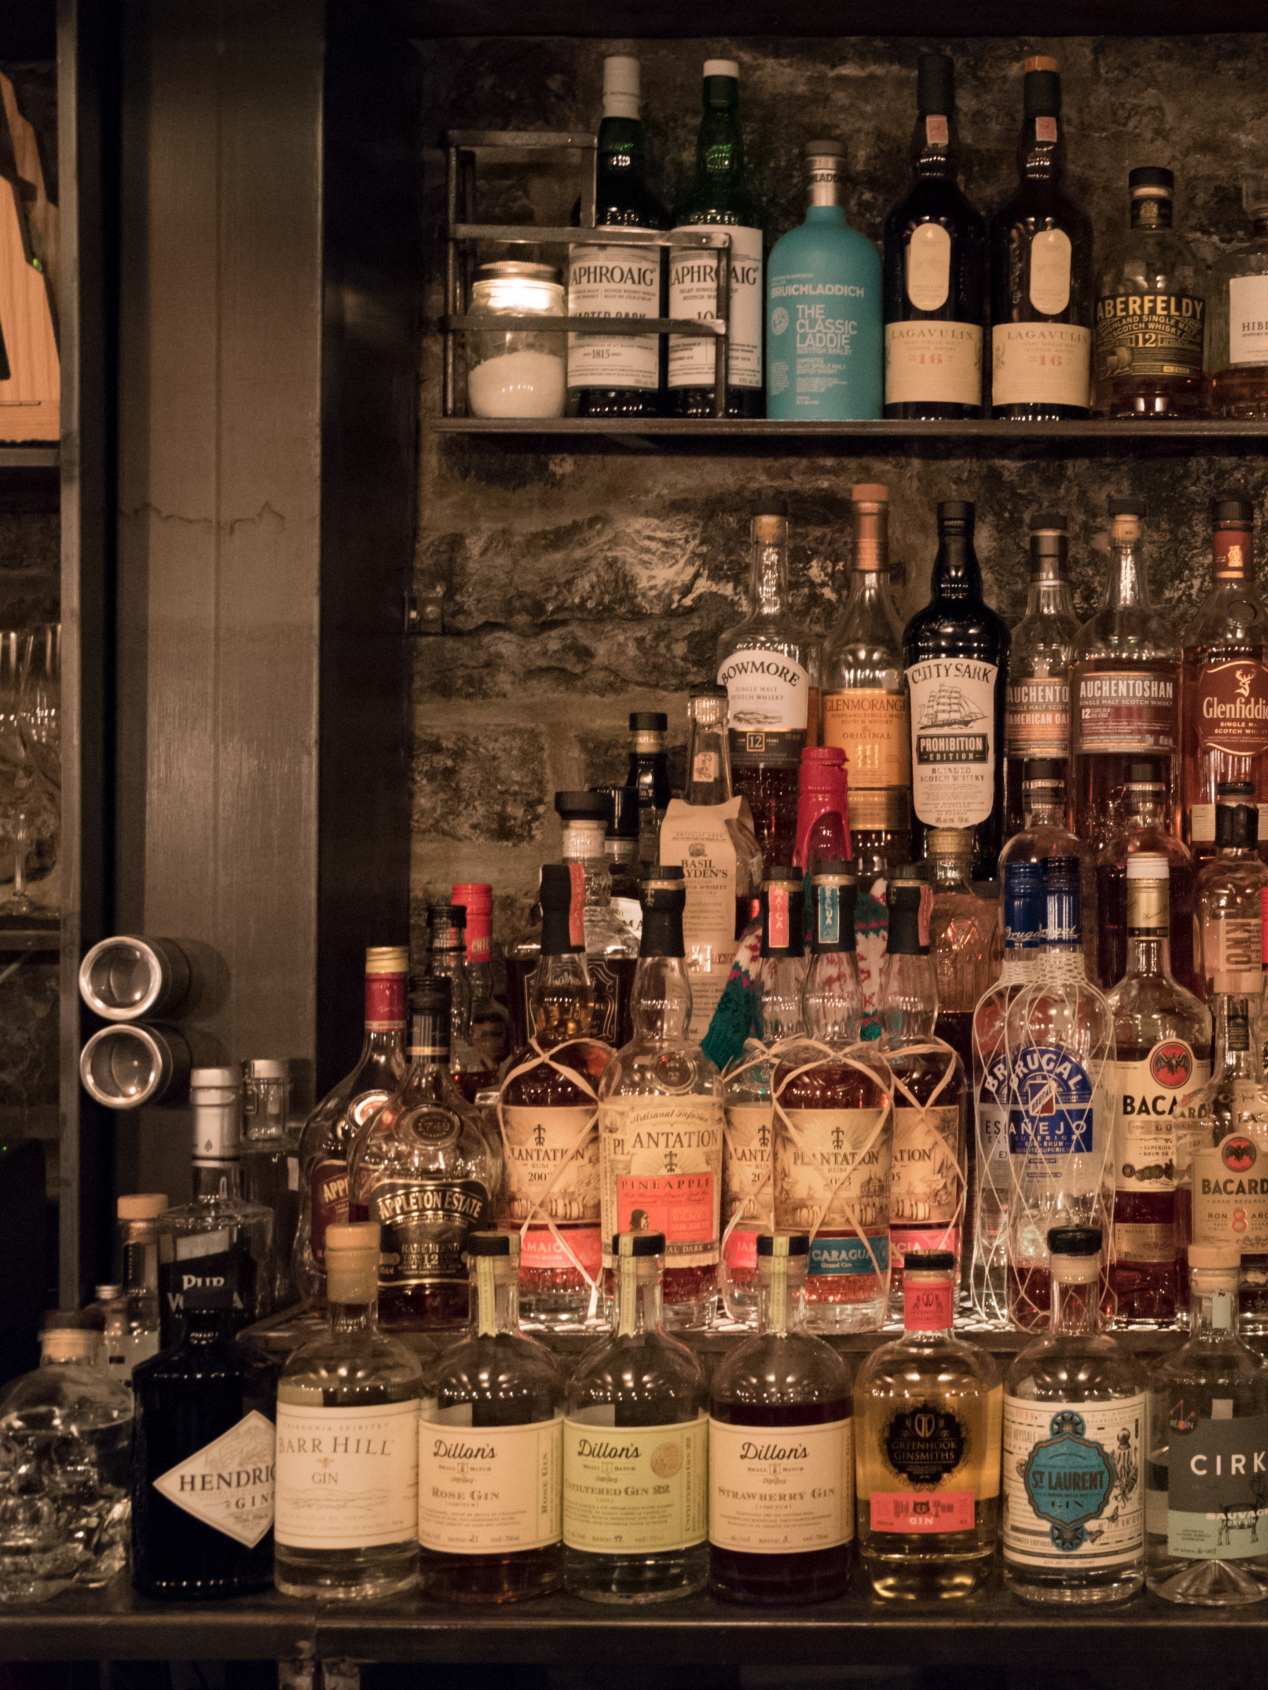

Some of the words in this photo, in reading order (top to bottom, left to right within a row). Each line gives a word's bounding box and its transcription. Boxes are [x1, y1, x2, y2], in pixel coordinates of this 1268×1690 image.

[570, 264, 655, 287] APHROAIG
[672, 264, 758, 287] LAPHRAIG
[796, 304, 825, 319] THE
[1096, 295, 1204, 322] ABERFELDY
[796, 319, 858, 335] CLASSIC
[891, 327, 976, 341] LAGAVULIN
[796, 333, 851, 349] LADDIE
[1007, 330, 1088, 345] LAGAVULIN
[1137, 332, 1157, 348] 12
[721, 660, 801, 688] BOWMORE
[954, 662, 993, 684] SARK
[1007, 686, 1070, 703] AUCHENTO
[1079, 680, 1174, 699] AUCHENTOSHAN
[825, 698, 906, 714] GLENMORANG
[1055, 712, 1070, 725] OA
[749, 735, 762, 748] 12
[920, 736, 984, 752] PROHIBITION
[929, 753, 975, 762] EDITION
[684, 868, 729, 879] YDEN'S
[1009, 1052, 1083, 1091] BRUGAL
[1122, 1094, 1178, 1116] BACA
[507, 1147, 586, 1162] LANTATIN
[528, 1172, 549, 1183] 200
[621, 1178, 712, 1191] PINEAPPLE
[378, 1191, 443, 1221] APPLETON
[446, 1191, 484, 1219] ESTATE
[1231, 1206, 1248, 1233] 8
[279, 1437, 323, 1455] BARR
[333, 1436, 392, 1456] HILL
[432, 1438, 497, 1460] Dillon's
[577, 1438, 641, 1460] Dillon's
[739, 1441, 810, 1461] Dillon's
[893, 1451, 956, 1461] GINSMITHS
[179, 1469, 276, 1493] HENDRIC
[311, 1471, 338, 1485] GIN
[1047, 1470, 1106, 1491] LAURENT
[469, 1489, 500, 1501] GIN
[624, 1486, 649, 1497] GIN
[718, 1486, 805, 1502] STRAWBERRY
[811, 1487, 836, 1499] GIN
[235, 1495, 270, 1511] GIN
[909, 1516, 934, 1526] GIN
